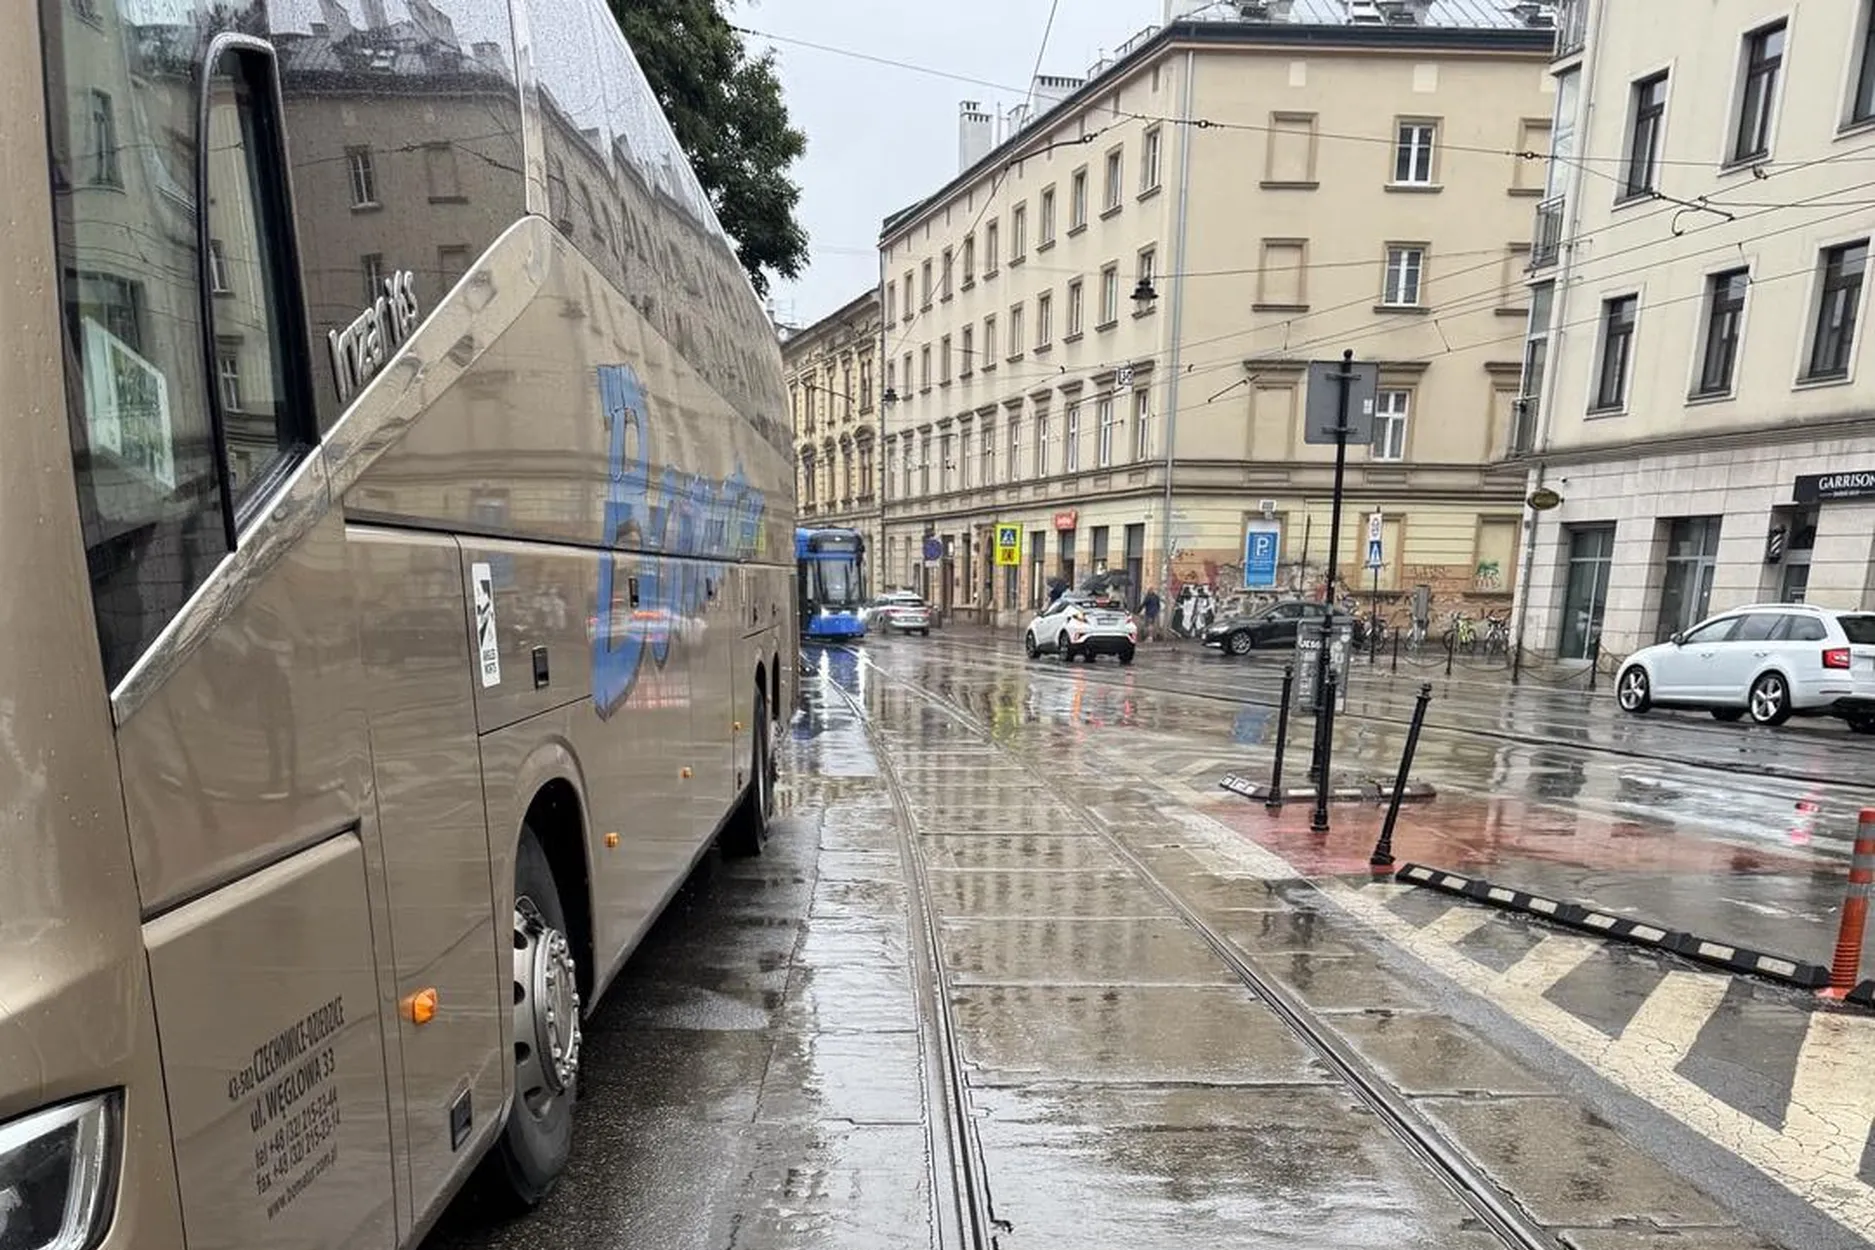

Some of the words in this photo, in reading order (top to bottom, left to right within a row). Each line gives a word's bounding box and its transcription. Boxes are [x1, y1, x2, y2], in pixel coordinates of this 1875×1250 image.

[250, 1097, 267, 1133] ul.
[265, 1056, 322, 1120] WĘGLOWA
[322, 1046, 335, 1078] 33
[256, 1172, 272, 1196] fax
